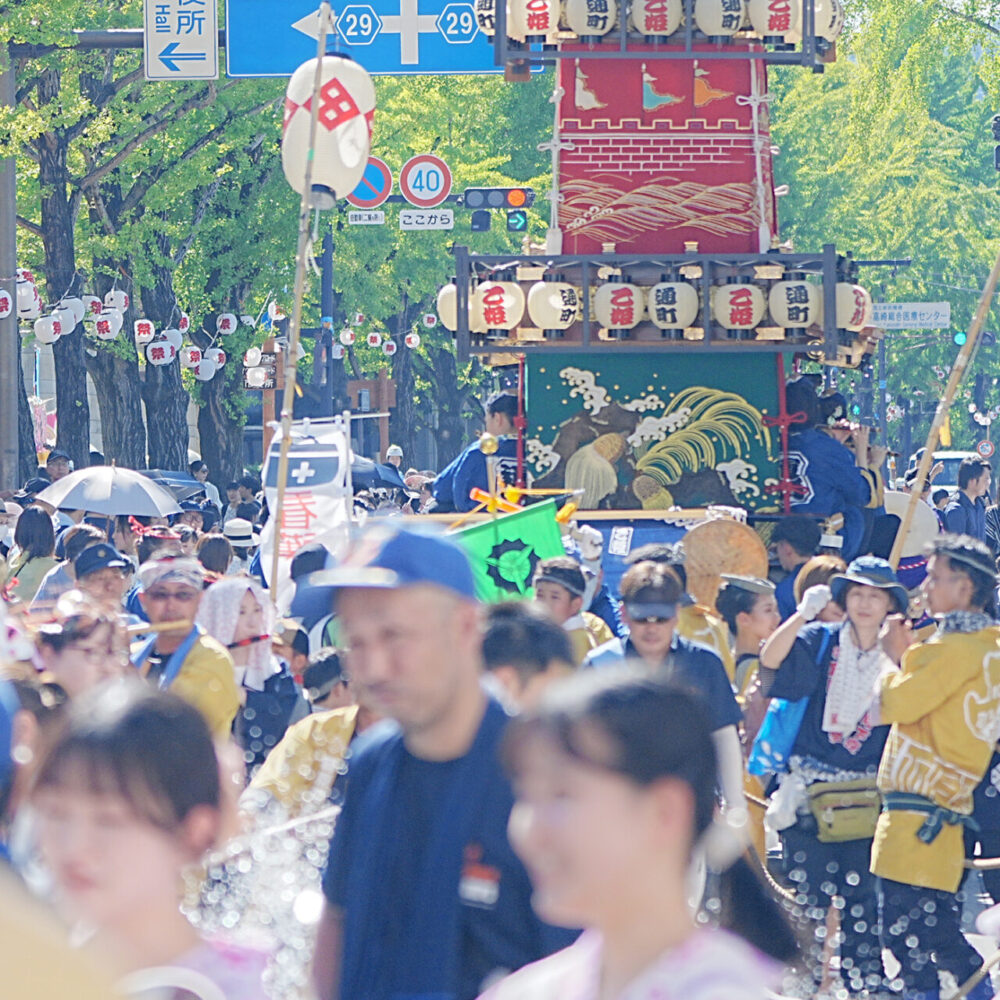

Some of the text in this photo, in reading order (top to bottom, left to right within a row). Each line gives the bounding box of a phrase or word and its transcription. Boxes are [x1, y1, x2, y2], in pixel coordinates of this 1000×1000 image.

[155, 4, 171, 33] Hall
[346, 14, 372, 36] 29
[446, 12, 473, 35] 29
[412, 170, 439, 192] 40
[403, 214, 451, 225] ここから
[655, 286, 677, 324] 通町
[786, 285, 809, 323] 通町
